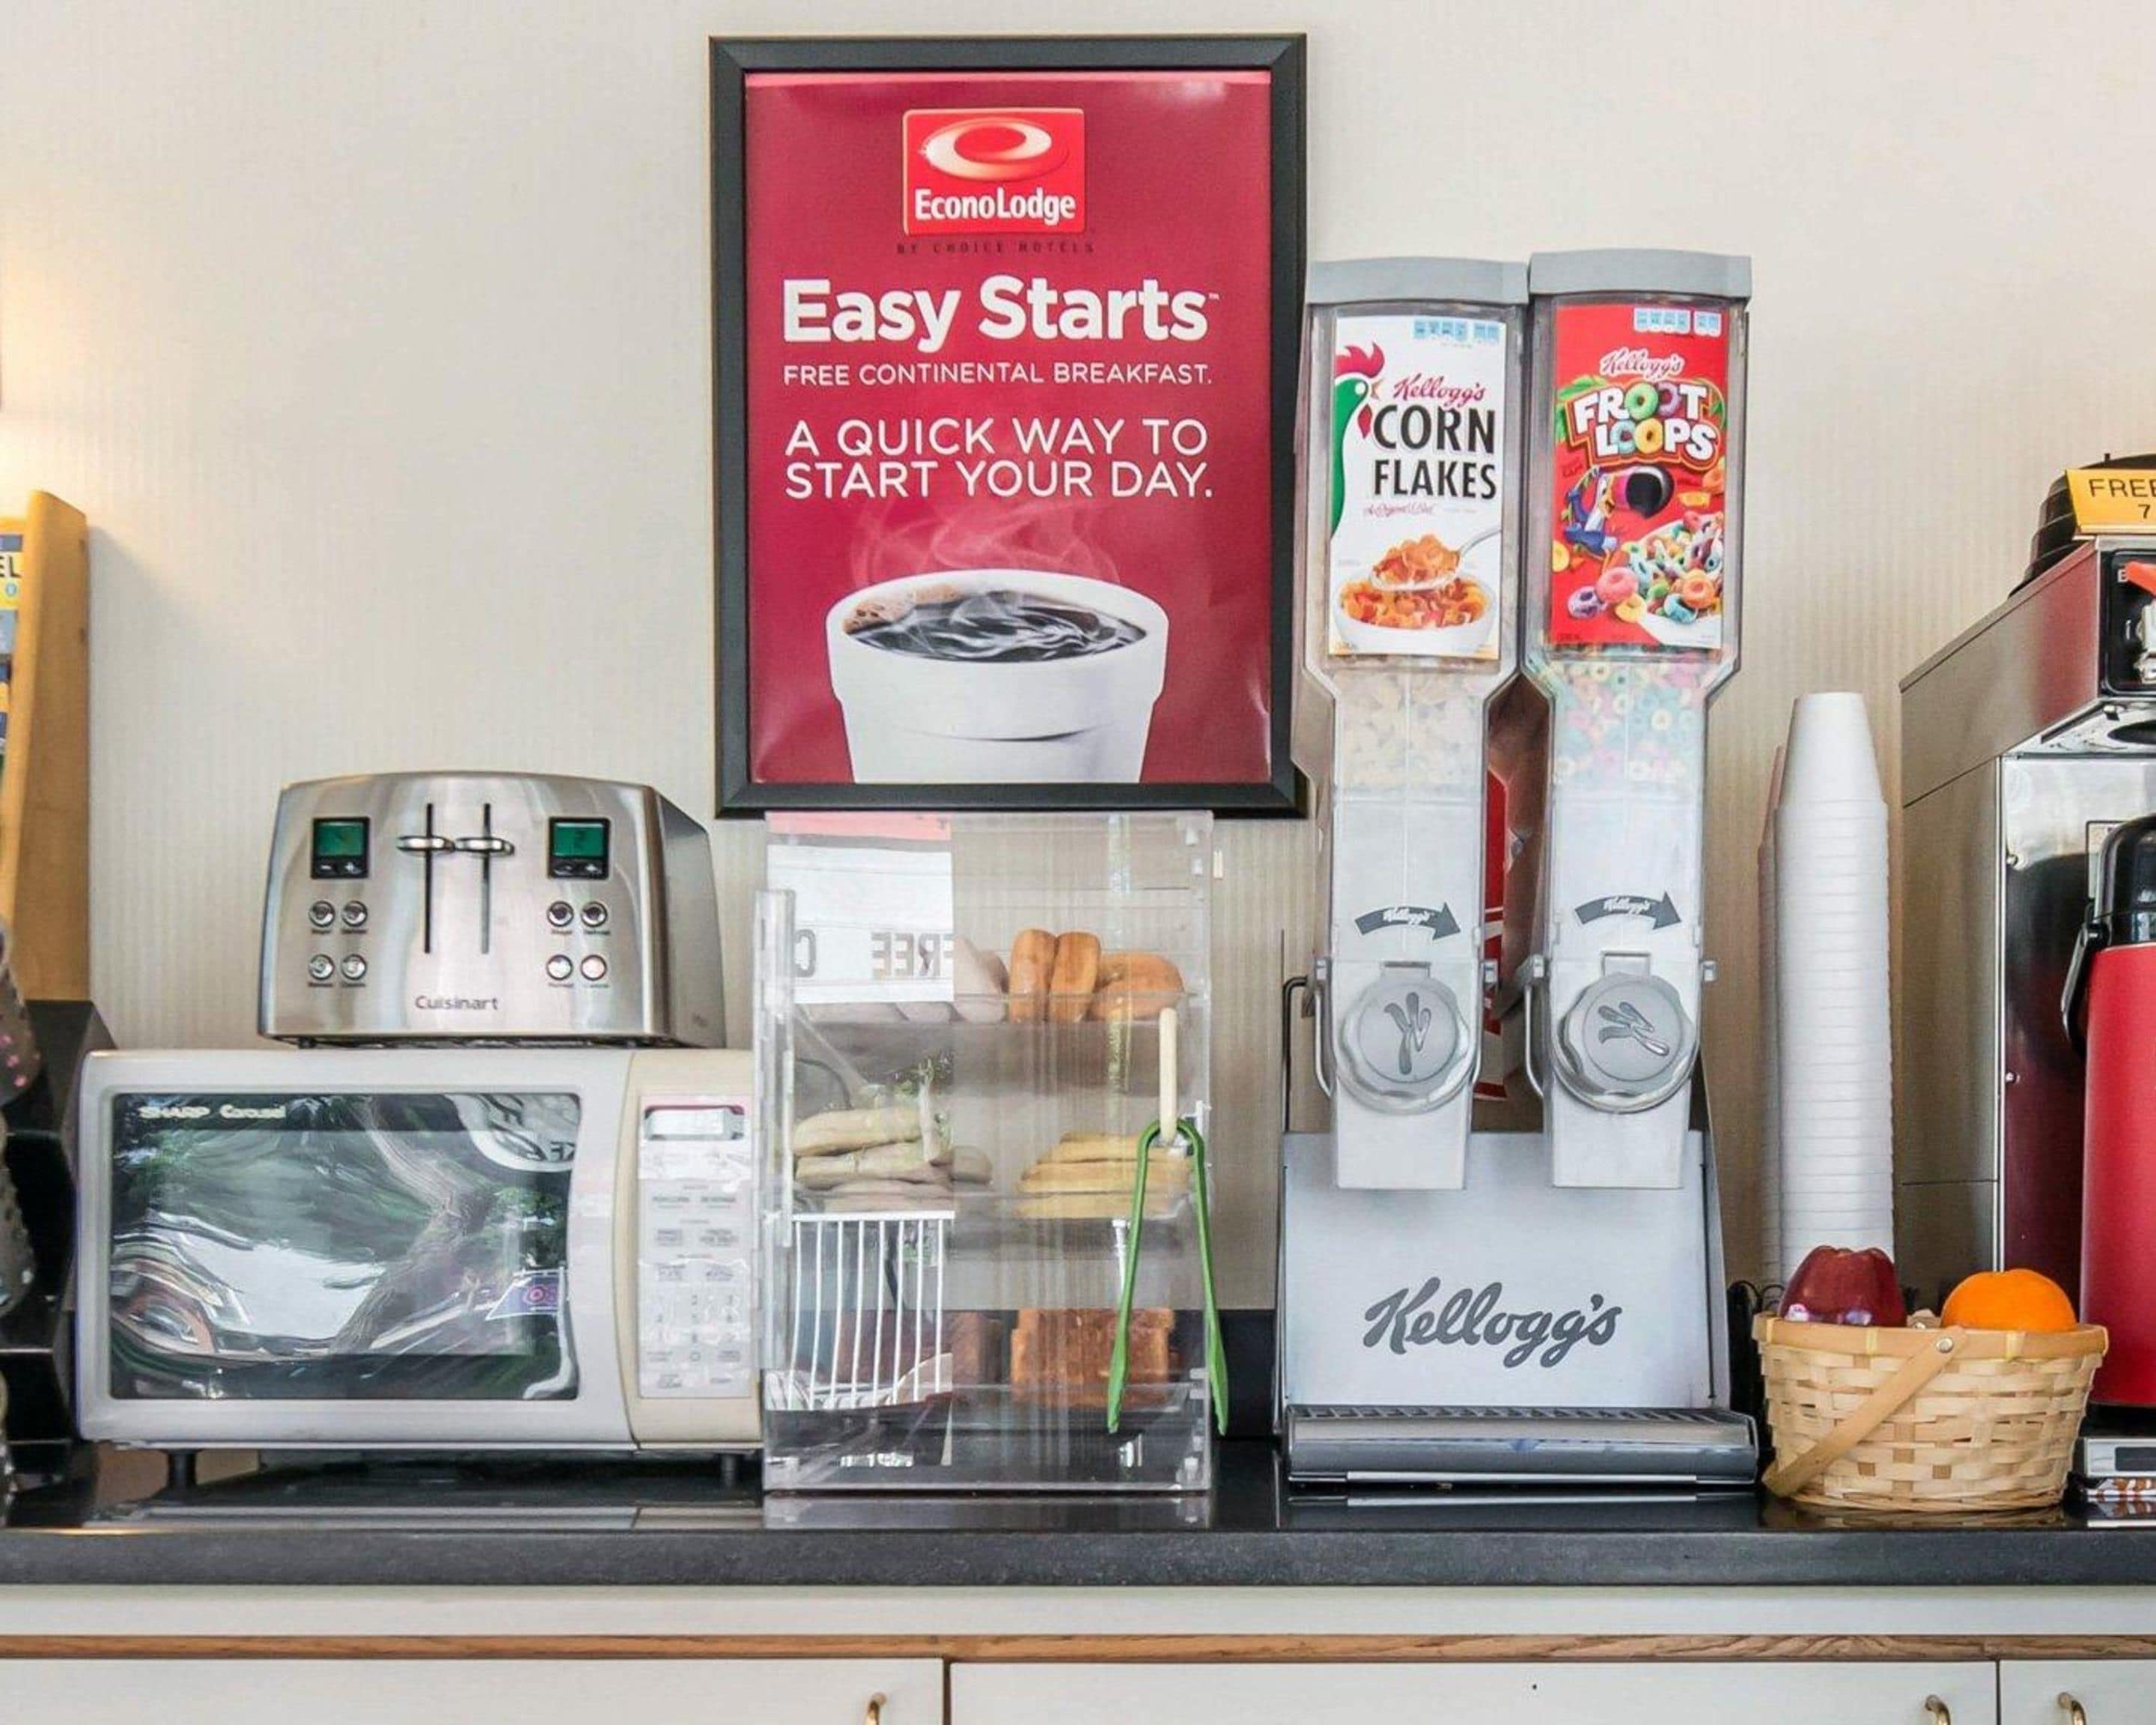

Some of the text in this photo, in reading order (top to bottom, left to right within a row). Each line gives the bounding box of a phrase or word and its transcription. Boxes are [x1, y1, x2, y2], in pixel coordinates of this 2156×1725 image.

[915, 187, 1077, 225] EconoLodge
[783, 278, 961, 353] Easy
[783, 362, 1212, 386] FREE CONTINENTAL BREAKFAST.
[1392, 373, 1486, 408] Kellogg's
[1572, 381, 1708, 435] FROOT
[785, 417, 1208, 456] A QUICK WAY TO
[1372, 404, 1496, 454] CORN
[1594, 417, 1717, 460] LOOPS
[785, 460, 1213, 499] START YOUR DAY.
[1374, 459, 1497, 500] FLAKES
[415, 994, 498, 1011] Cuisinart
[1362, 1276, 1623, 1369] Kellogg's
